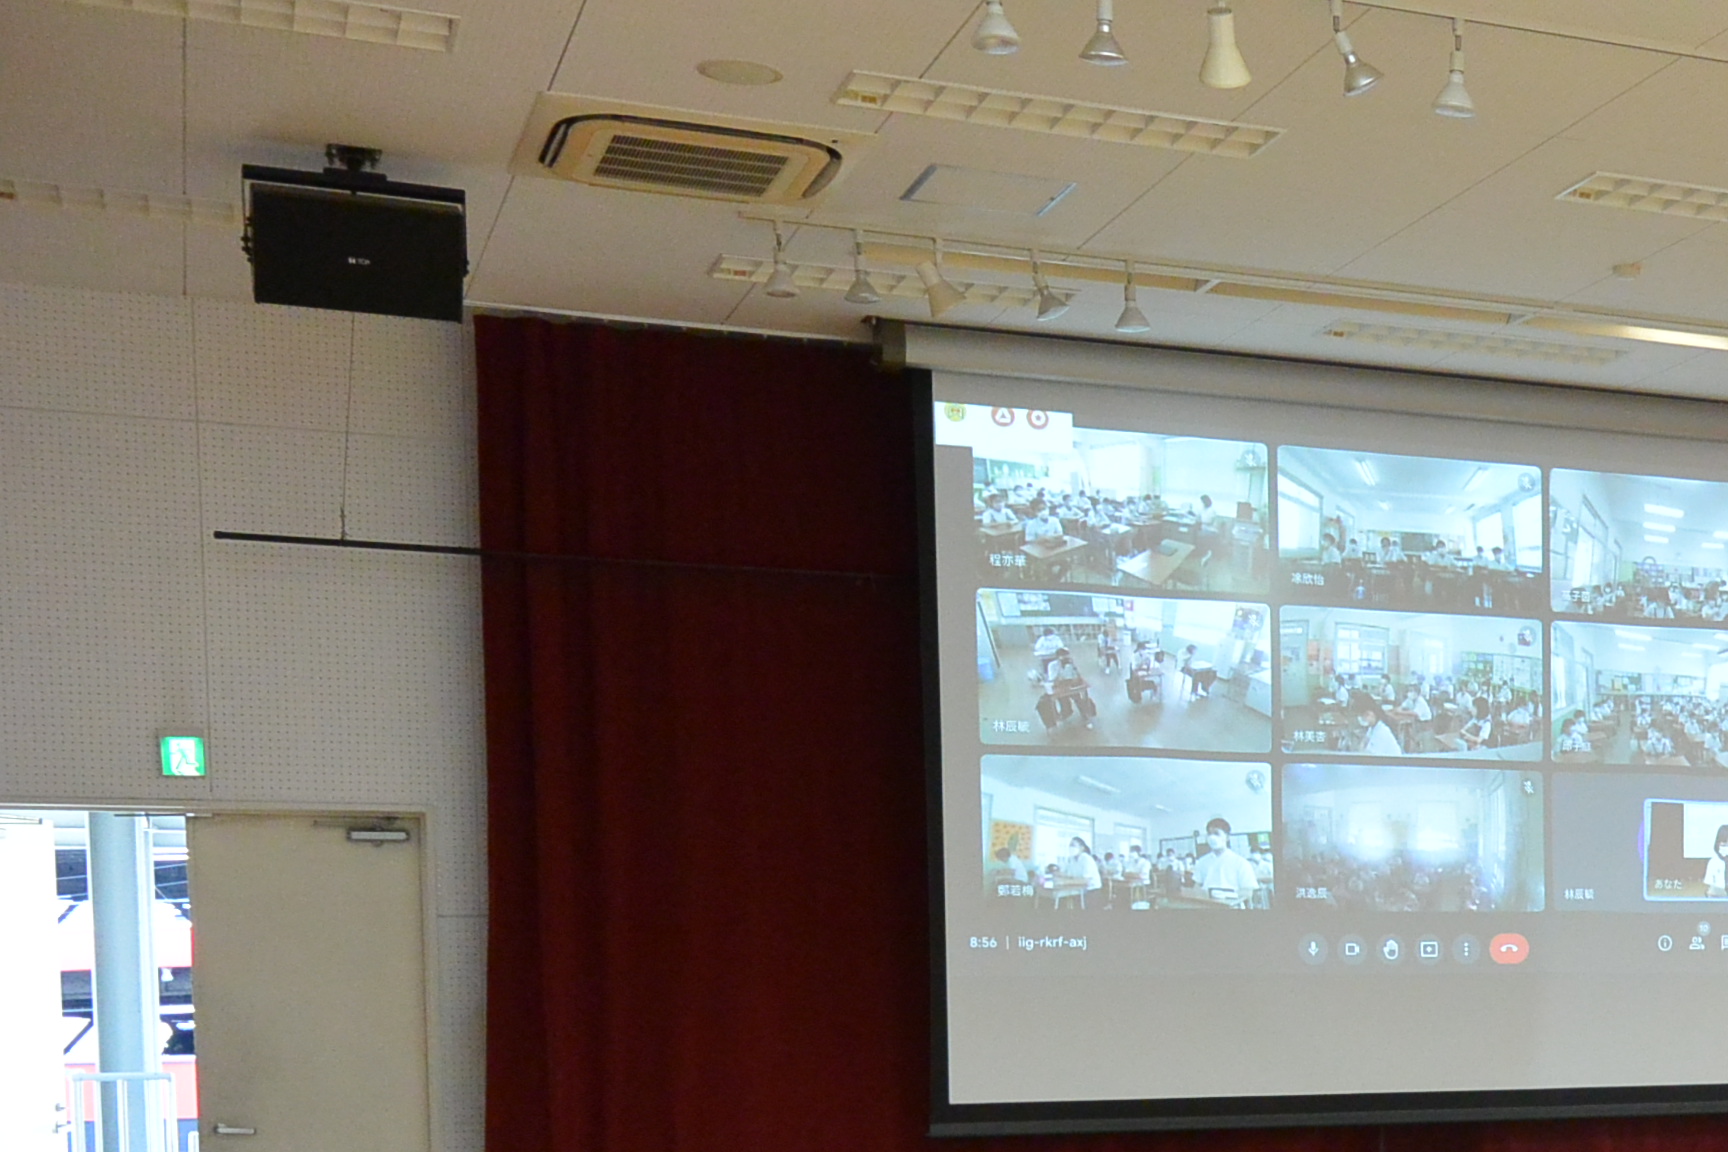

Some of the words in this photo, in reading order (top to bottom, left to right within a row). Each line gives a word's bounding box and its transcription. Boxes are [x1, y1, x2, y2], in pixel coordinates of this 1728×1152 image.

[1654, 879, 1682, 890] あなた
[969, 936, 998, 949] 8:56
